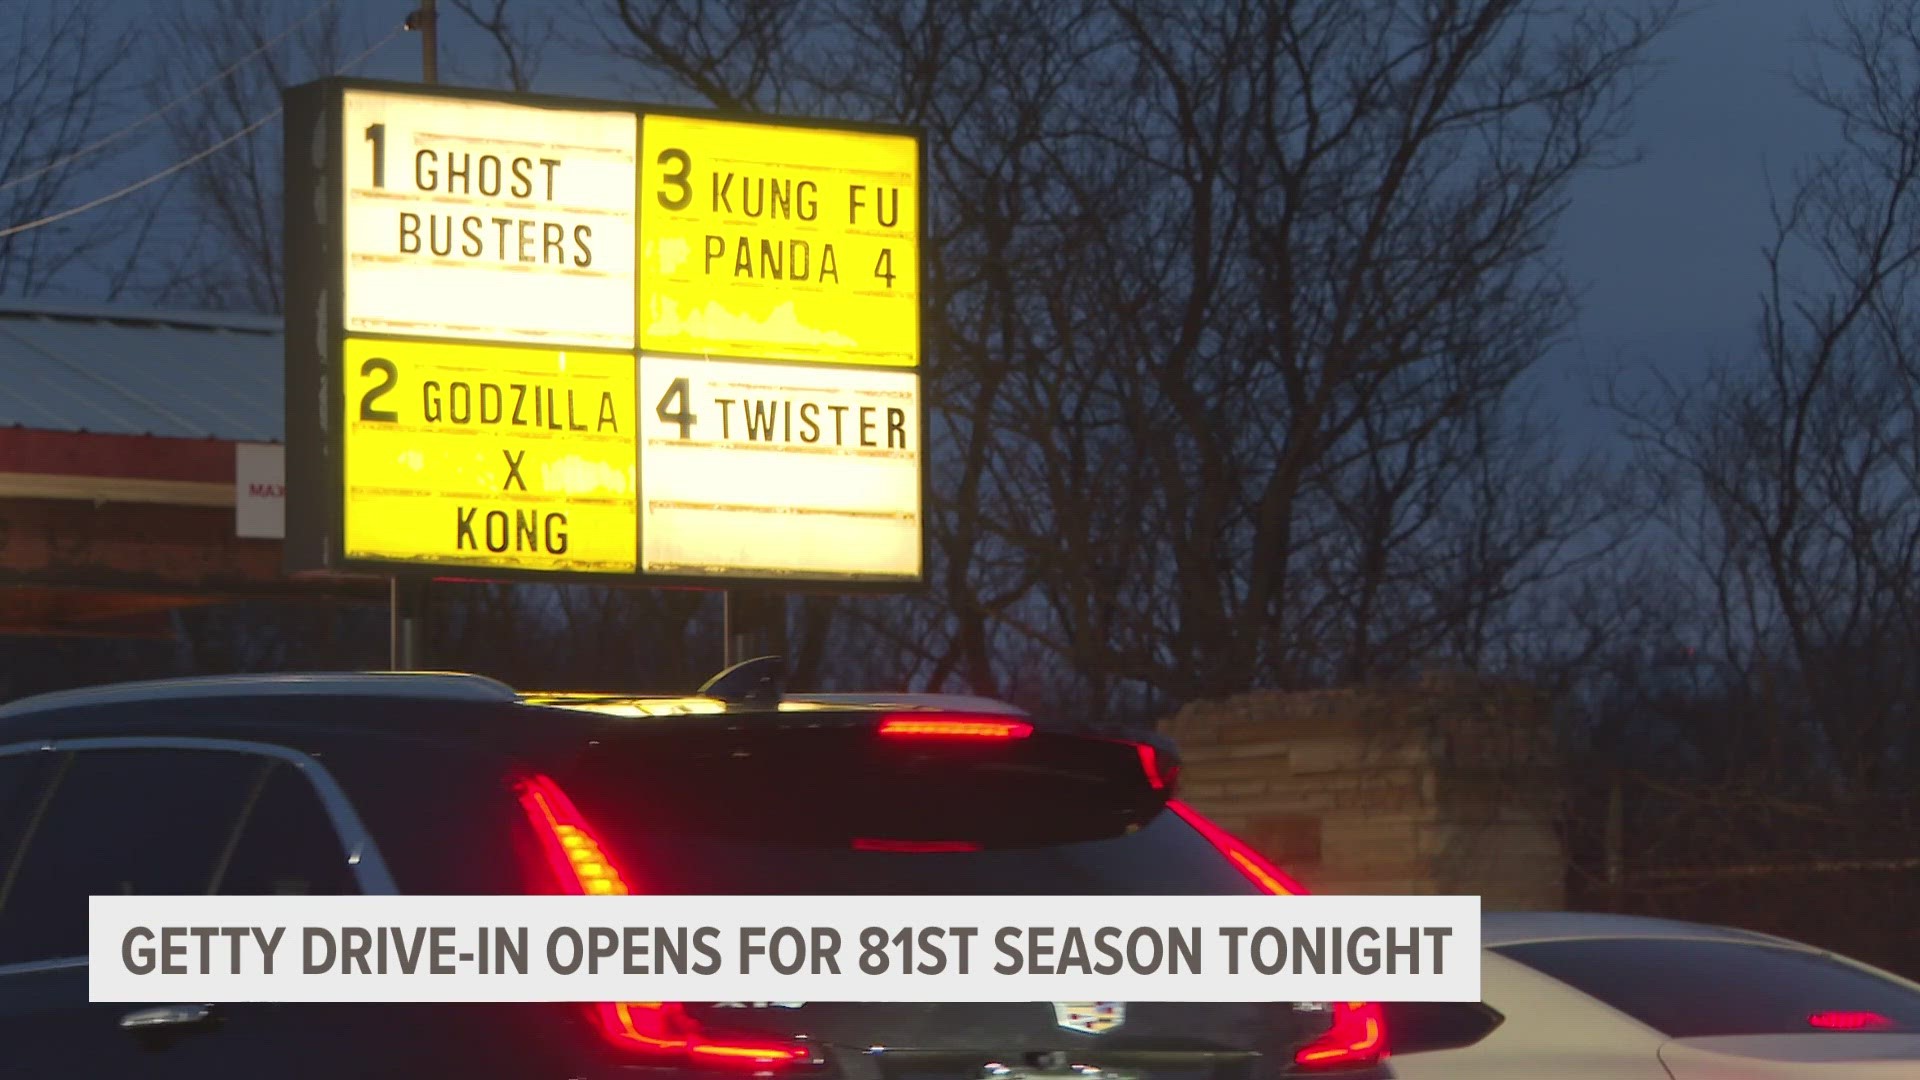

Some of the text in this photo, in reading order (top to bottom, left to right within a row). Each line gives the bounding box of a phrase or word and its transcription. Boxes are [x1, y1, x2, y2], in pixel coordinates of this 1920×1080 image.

[364, 123, 561, 201] 1 GHOST
[657, 148, 899, 228] 3 KUNG FU
[400, 212, 592, 268] BUSTERS
[705, 234, 896, 288] PANDA 4
[360, 357, 618, 433] 2 GODZILLA
[656, 377, 906, 449] 4 TWISTER
[503, 449, 527, 491] X
[457, 506, 567, 555] KONG
